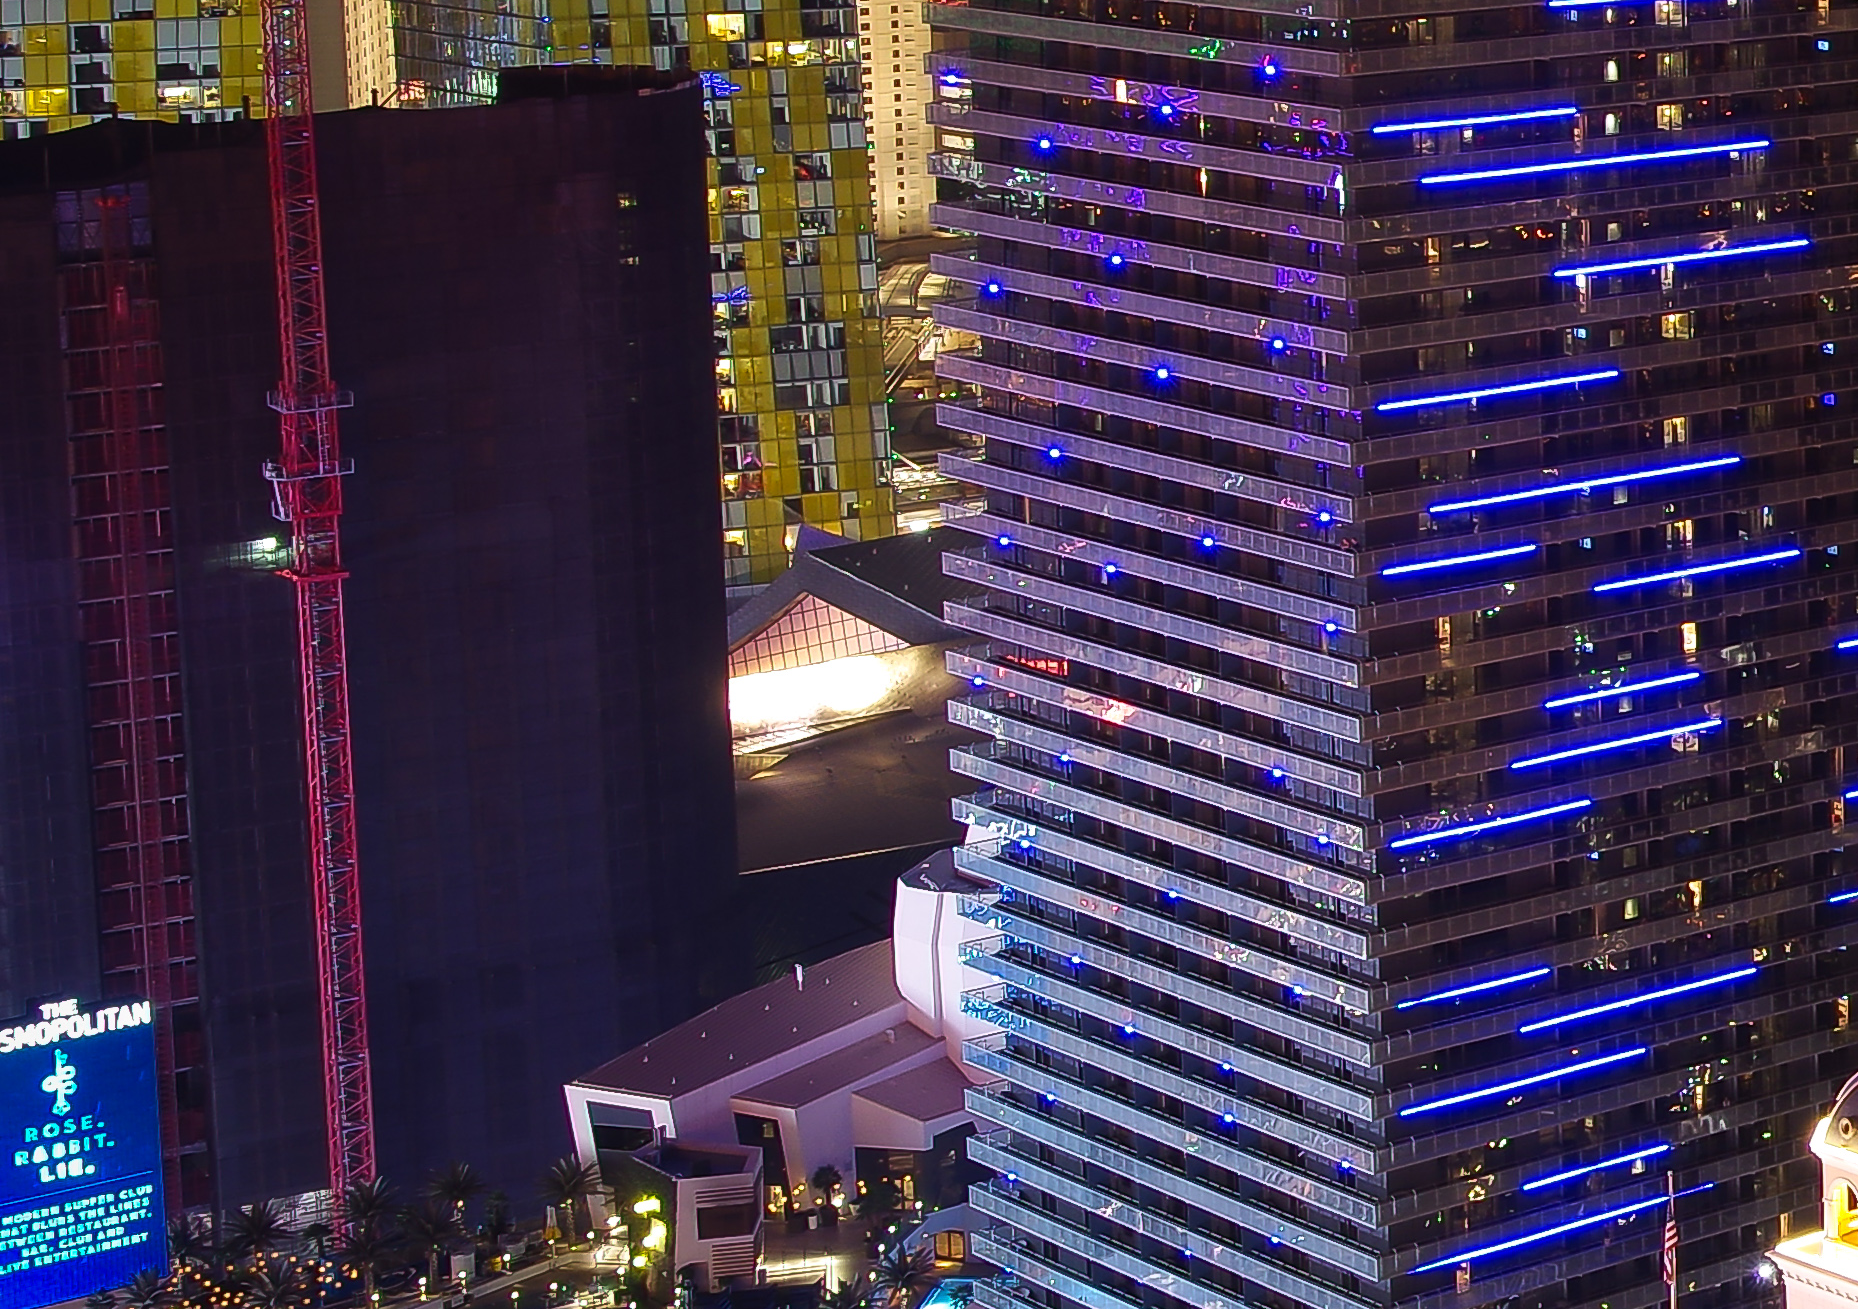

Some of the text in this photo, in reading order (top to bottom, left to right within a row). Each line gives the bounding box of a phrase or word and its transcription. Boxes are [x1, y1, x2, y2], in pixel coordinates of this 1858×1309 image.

[40, 1000, 78, 1020] THE
[25, 1115, 105, 1142] ROSE.
[15, 1133, 114, 1166] RABBIT.
[40, 1158, 95, 1182] LIE.
[2, 1185, 153, 1225] MODERN SUPPER CLUB
[78, 1207, 105, 1220] THE
[109, 1197, 150, 1214] LINES
[34, 1232, 148, 1267] ENTERTAINMENT
[59, 1233, 93, 1249] CLUB
[97, 1227, 124, 1240] AND
